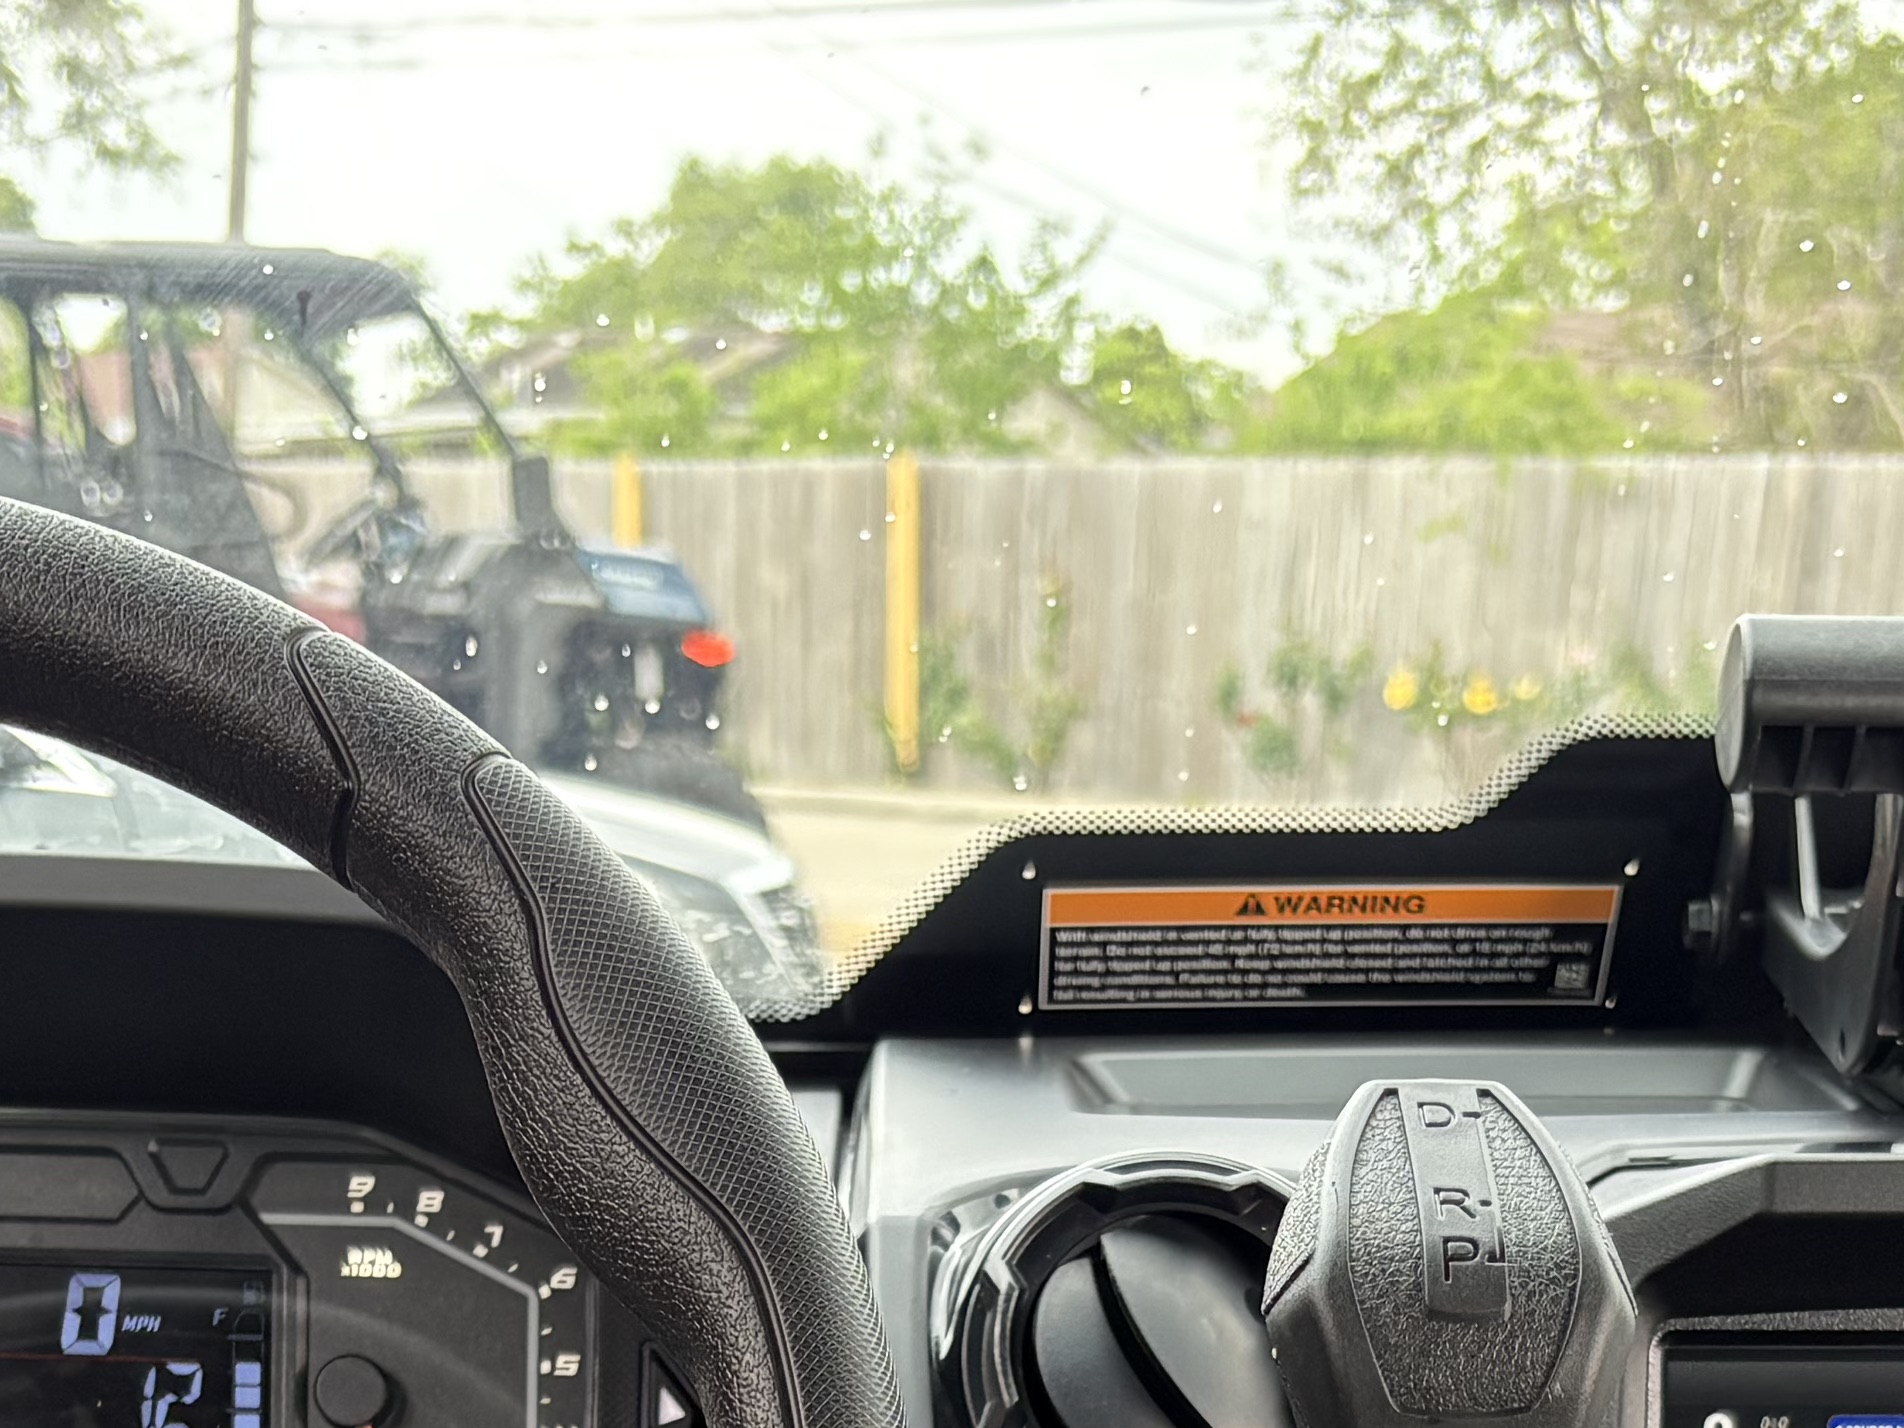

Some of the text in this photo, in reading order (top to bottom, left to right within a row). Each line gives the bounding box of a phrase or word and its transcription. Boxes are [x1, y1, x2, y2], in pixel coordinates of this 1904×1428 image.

[1273, 894, 1427, 916] WARNING
[1417, 1101, 1456, 1128] D
[347, 1173, 376, 1197] 9
[416, 1189, 444, 1212] 8
[1433, 1187, 1477, 1220] R
[484, 1225, 503, 1247] 7
[346, 1245, 395, 1265] RPM
[1442, 1236, 1481, 1283] P
[550, 1266, 578, 1290] 6
[61, 1272, 162, 1356] 0 MPH
[213, 1308, 228, 1326] F
[554, 1352, 581, 1377] 5
